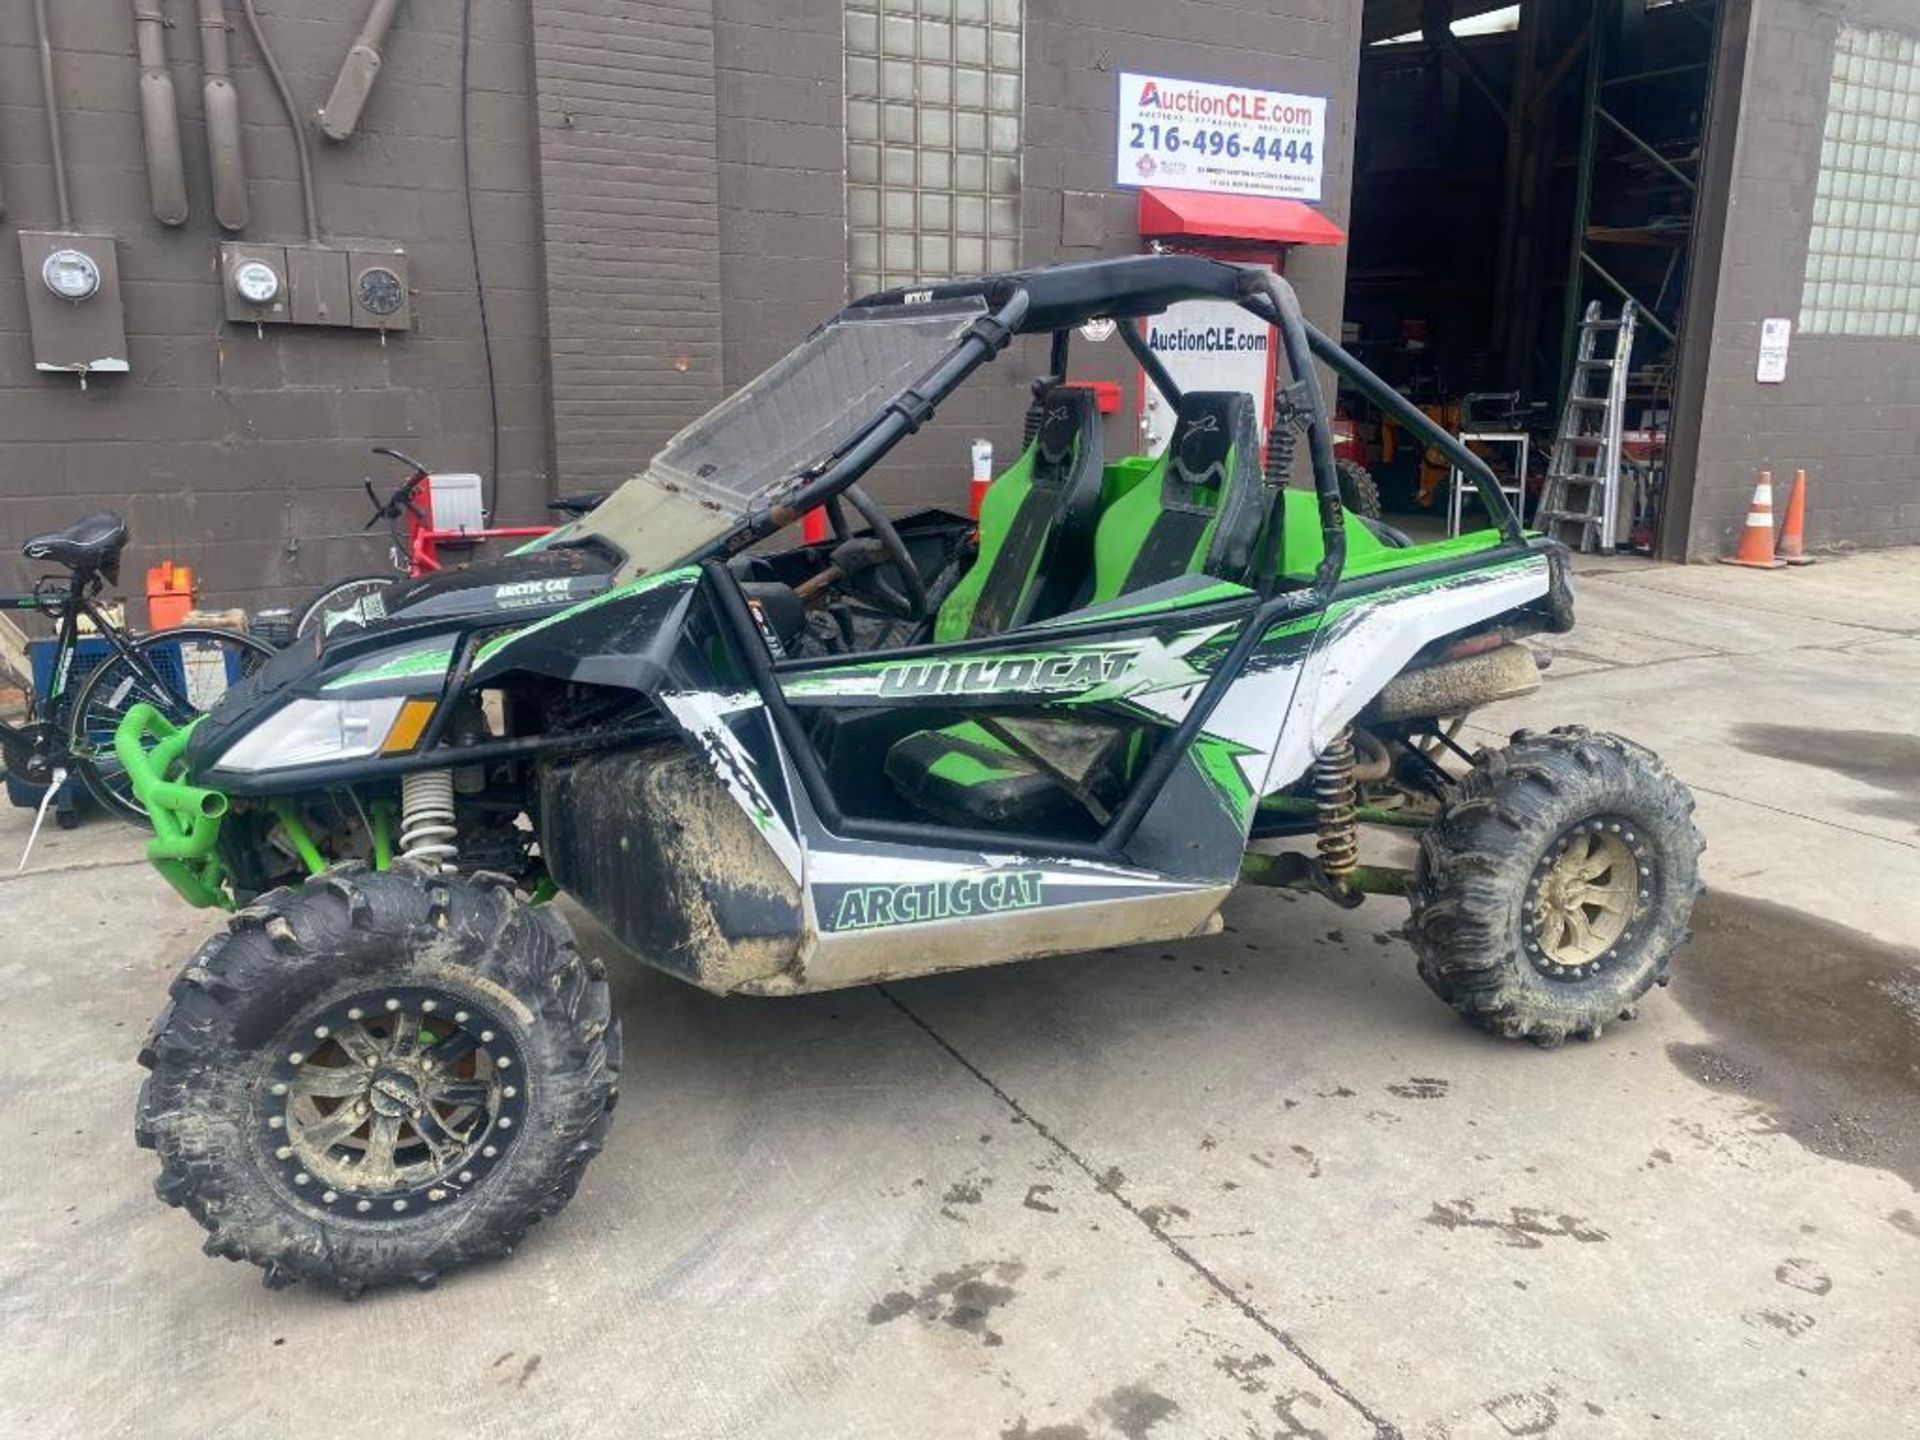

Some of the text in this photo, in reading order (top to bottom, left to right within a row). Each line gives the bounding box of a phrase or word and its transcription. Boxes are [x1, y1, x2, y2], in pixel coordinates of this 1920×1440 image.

[1138, 81, 1312, 126] AuctionCLE.com
[1129, 122, 1314, 165] 216-496-4444
[1150, 327, 1267, 351] AuctionCLE.com
[495, 578, 572, 598] ARCTIC CAT
[878, 652, 1140, 698] WILDCAT
[834, 871, 1043, 930] ARCTIC CAT
